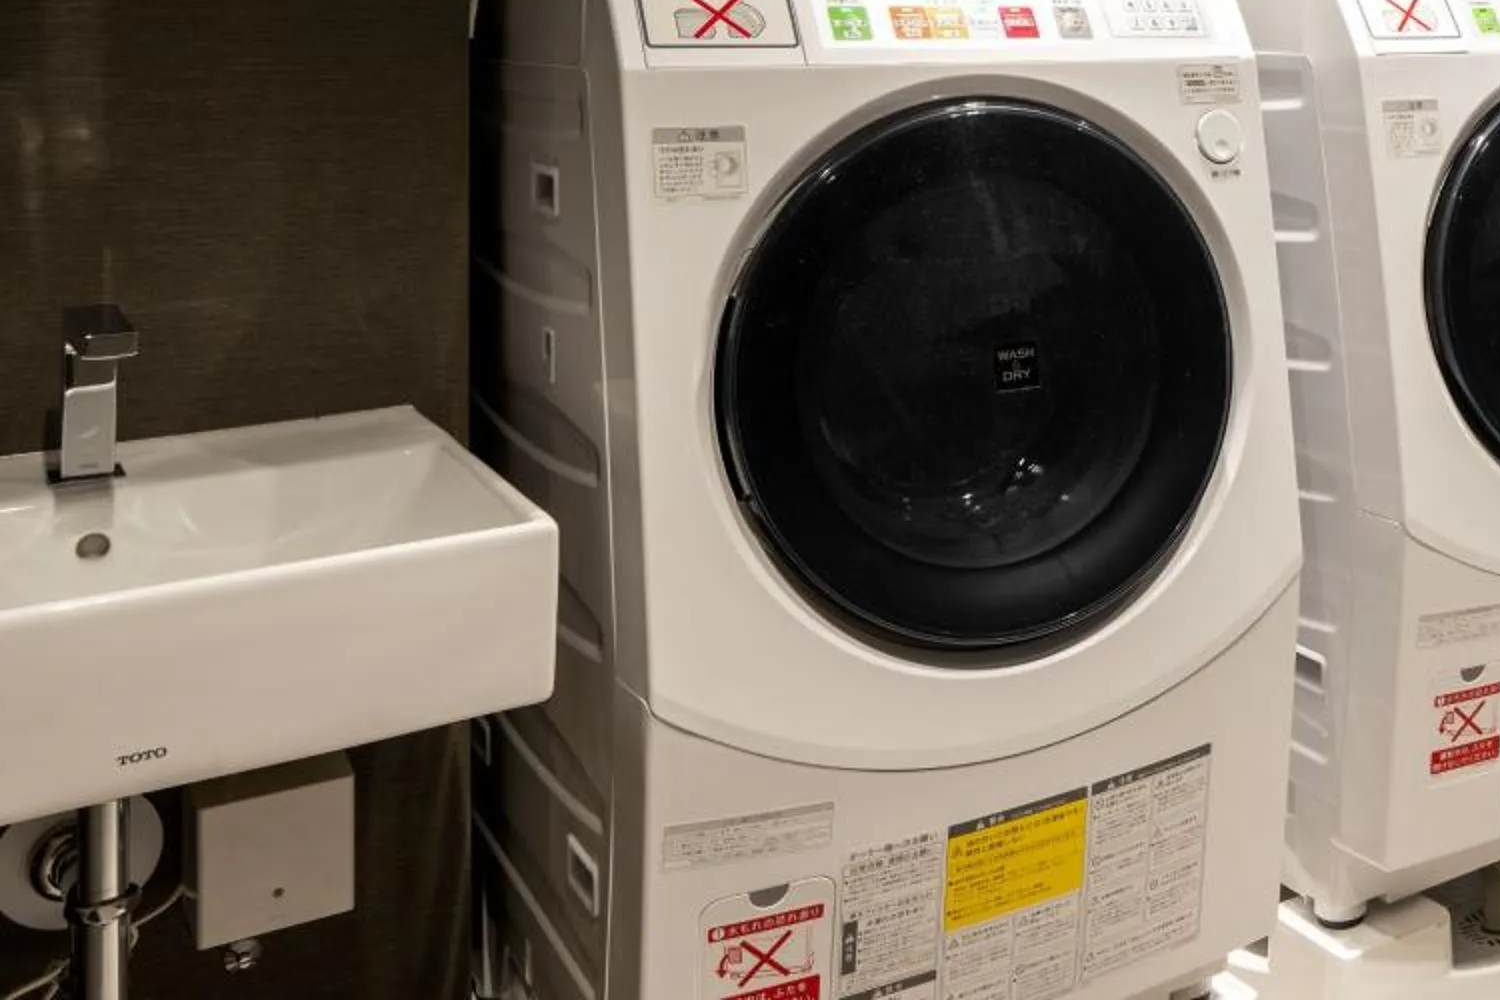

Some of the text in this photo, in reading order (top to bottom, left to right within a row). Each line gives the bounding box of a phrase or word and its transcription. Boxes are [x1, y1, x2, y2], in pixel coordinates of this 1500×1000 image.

[997, 347, 1035, 361] WASH
[1002, 367, 1031, 382] DRY
[117, 747, 168, 766] TOTO
